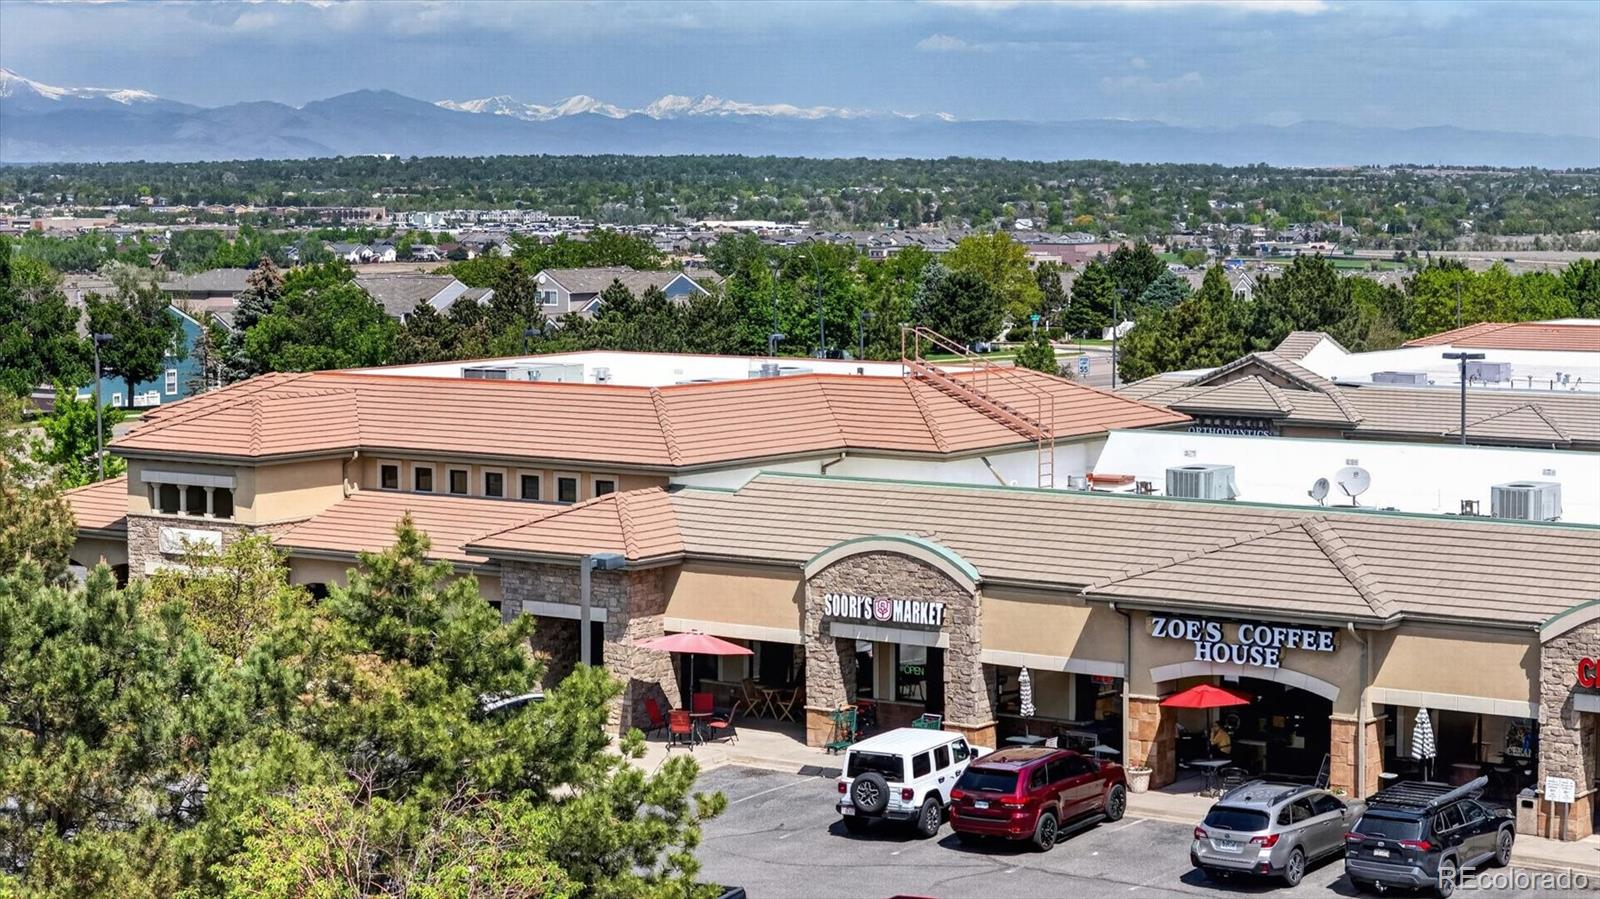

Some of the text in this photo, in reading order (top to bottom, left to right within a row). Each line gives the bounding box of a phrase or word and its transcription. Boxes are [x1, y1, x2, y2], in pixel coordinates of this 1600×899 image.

[824, 593, 944, 625] SOORI'S MARKET
[1152, 618, 1334, 651] ZOE'S COFFEE
[1194, 641, 1280, 668] HOUSE
[903, 665, 925, 676] OPEN
[1578, 657, 1600, 688] C
